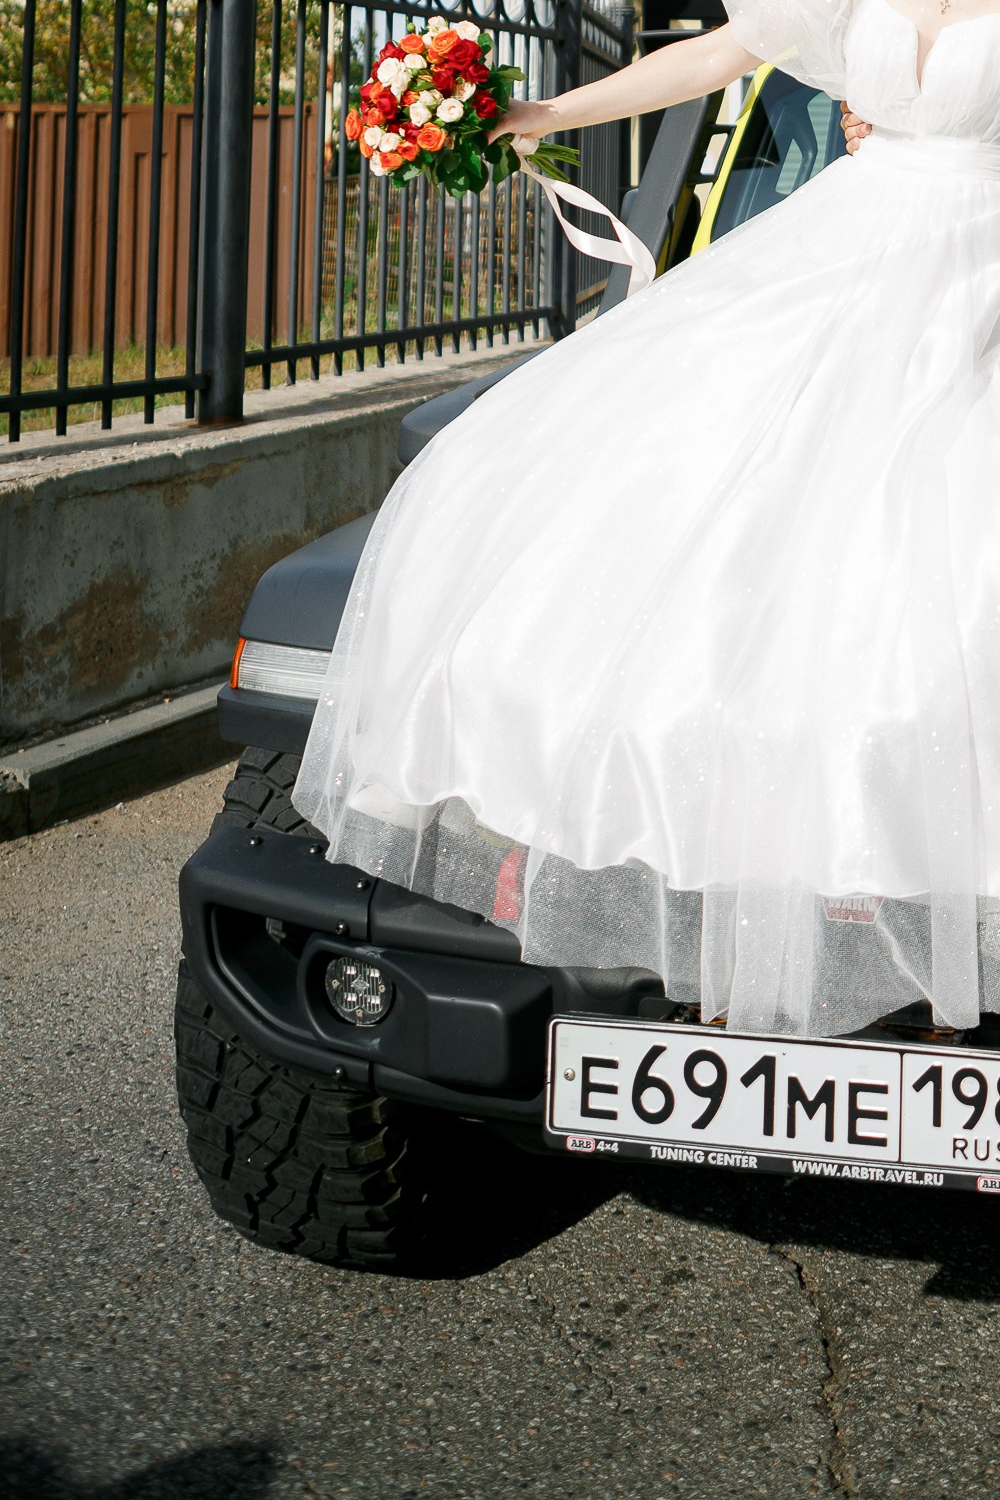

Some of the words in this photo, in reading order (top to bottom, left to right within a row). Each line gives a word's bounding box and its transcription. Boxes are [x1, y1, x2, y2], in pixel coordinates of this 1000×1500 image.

[581, 1044, 889, 1148] E691ME
[650, 1145, 705, 1163] TUNING
[707, 1152, 758, 1169] CENTER
[792, 1159, 944, 1187] WWW.ARBTRAVEL.RU
